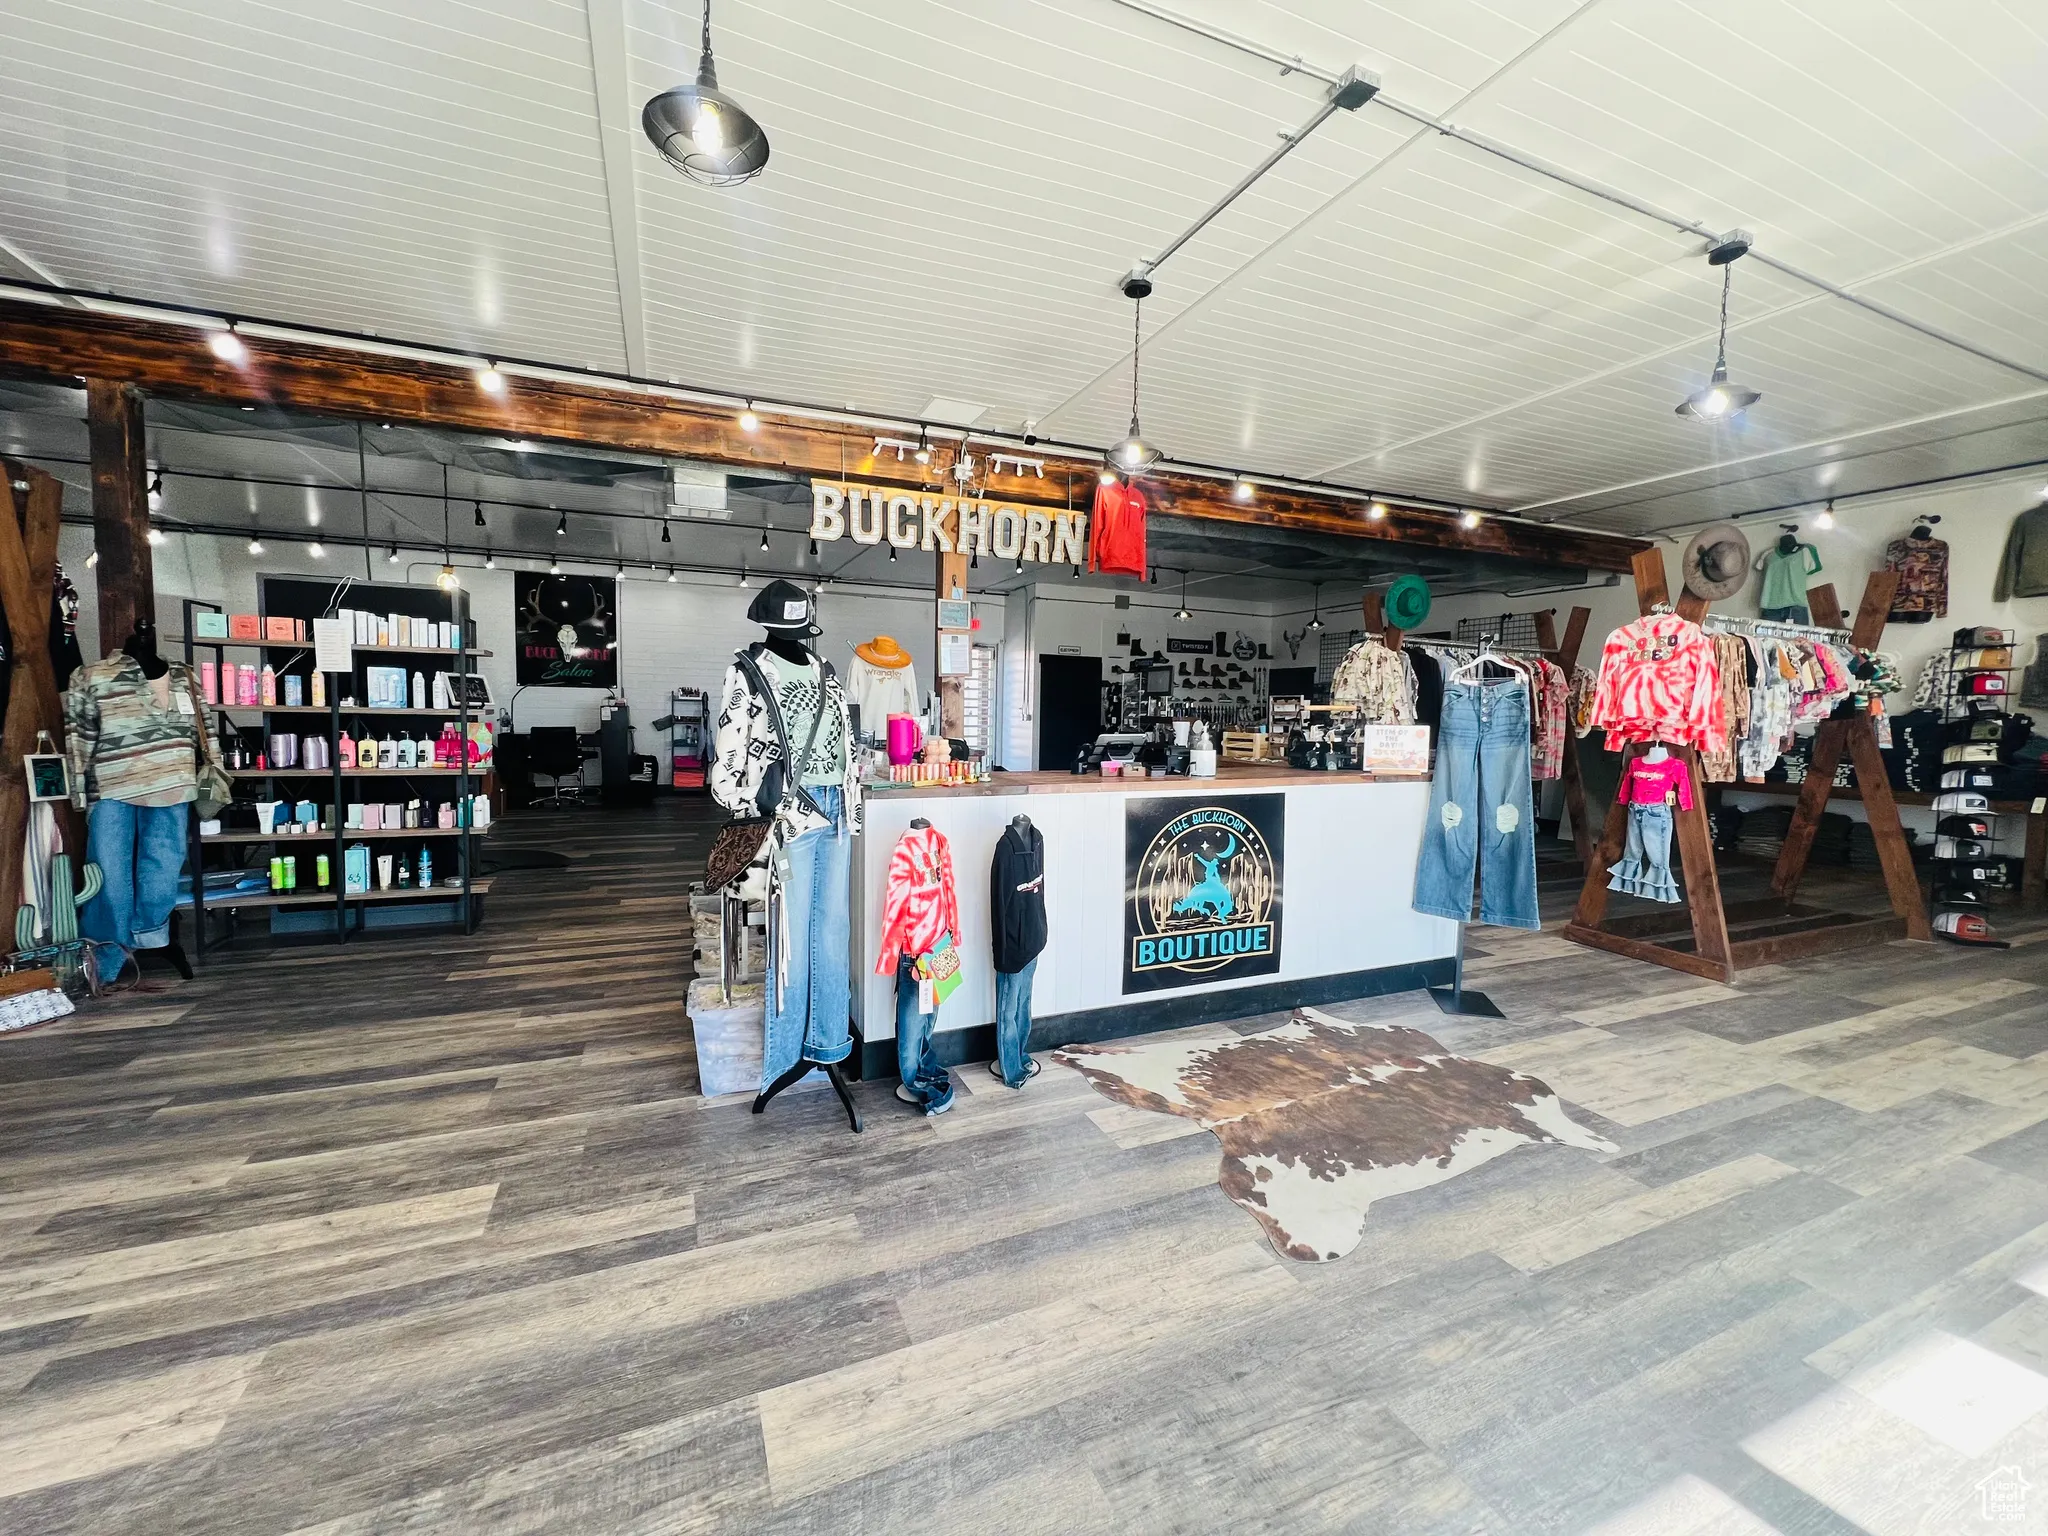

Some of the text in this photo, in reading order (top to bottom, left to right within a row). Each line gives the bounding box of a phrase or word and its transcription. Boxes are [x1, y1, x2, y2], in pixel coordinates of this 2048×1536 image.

[810, 484, 1087, 566] BUCKHORN
[1628, 635, 1678, 651] RODEO
[1627, 649, 1673, 662] VIBES
[541, 660, 595, 680] Salon
[1376, 728, 1396, 736] ITEM
[1168, 811, 1247, 836] THE BUCKHORN
[1139, 927, 1268, 966] BOUTIQUE
